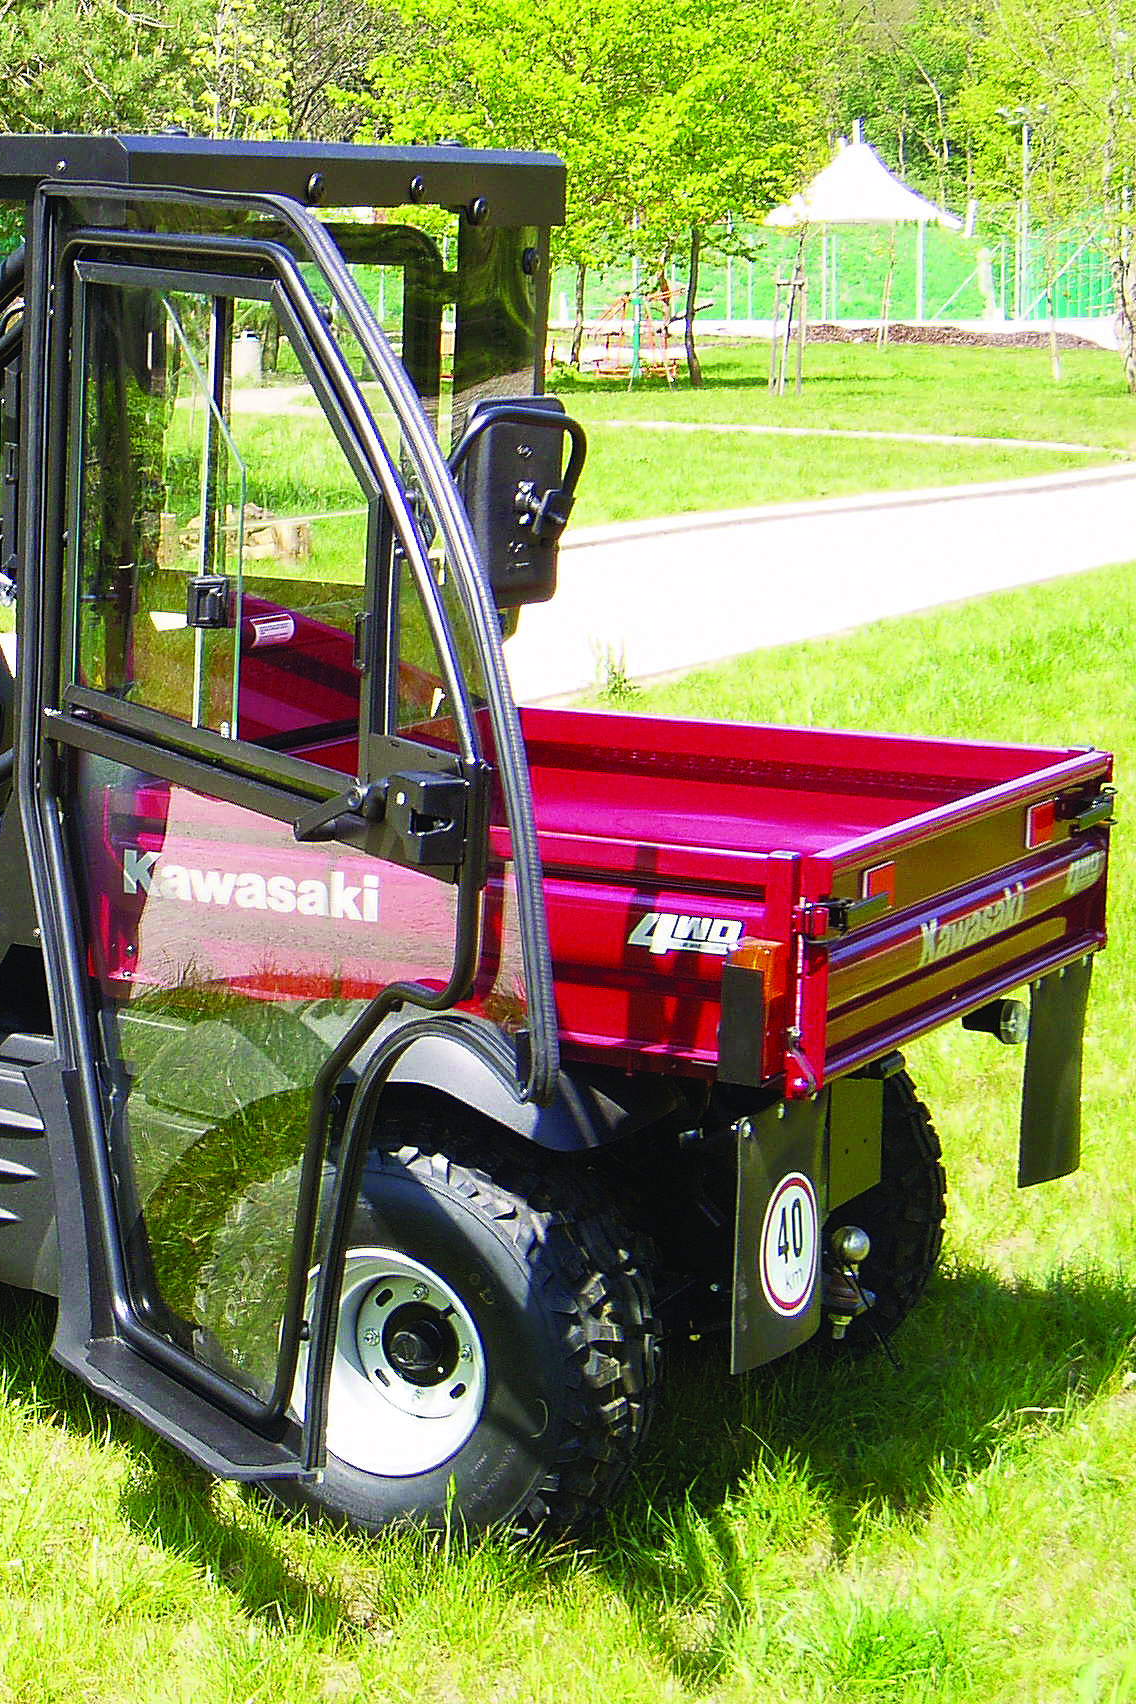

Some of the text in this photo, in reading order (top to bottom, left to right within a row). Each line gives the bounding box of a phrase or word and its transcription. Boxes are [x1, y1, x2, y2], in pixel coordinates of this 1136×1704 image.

[123, 848, 379, 923] Kawasaki
[627, 912, 745, 955] 4WD
[778, 1198, 804, 1264] 40
